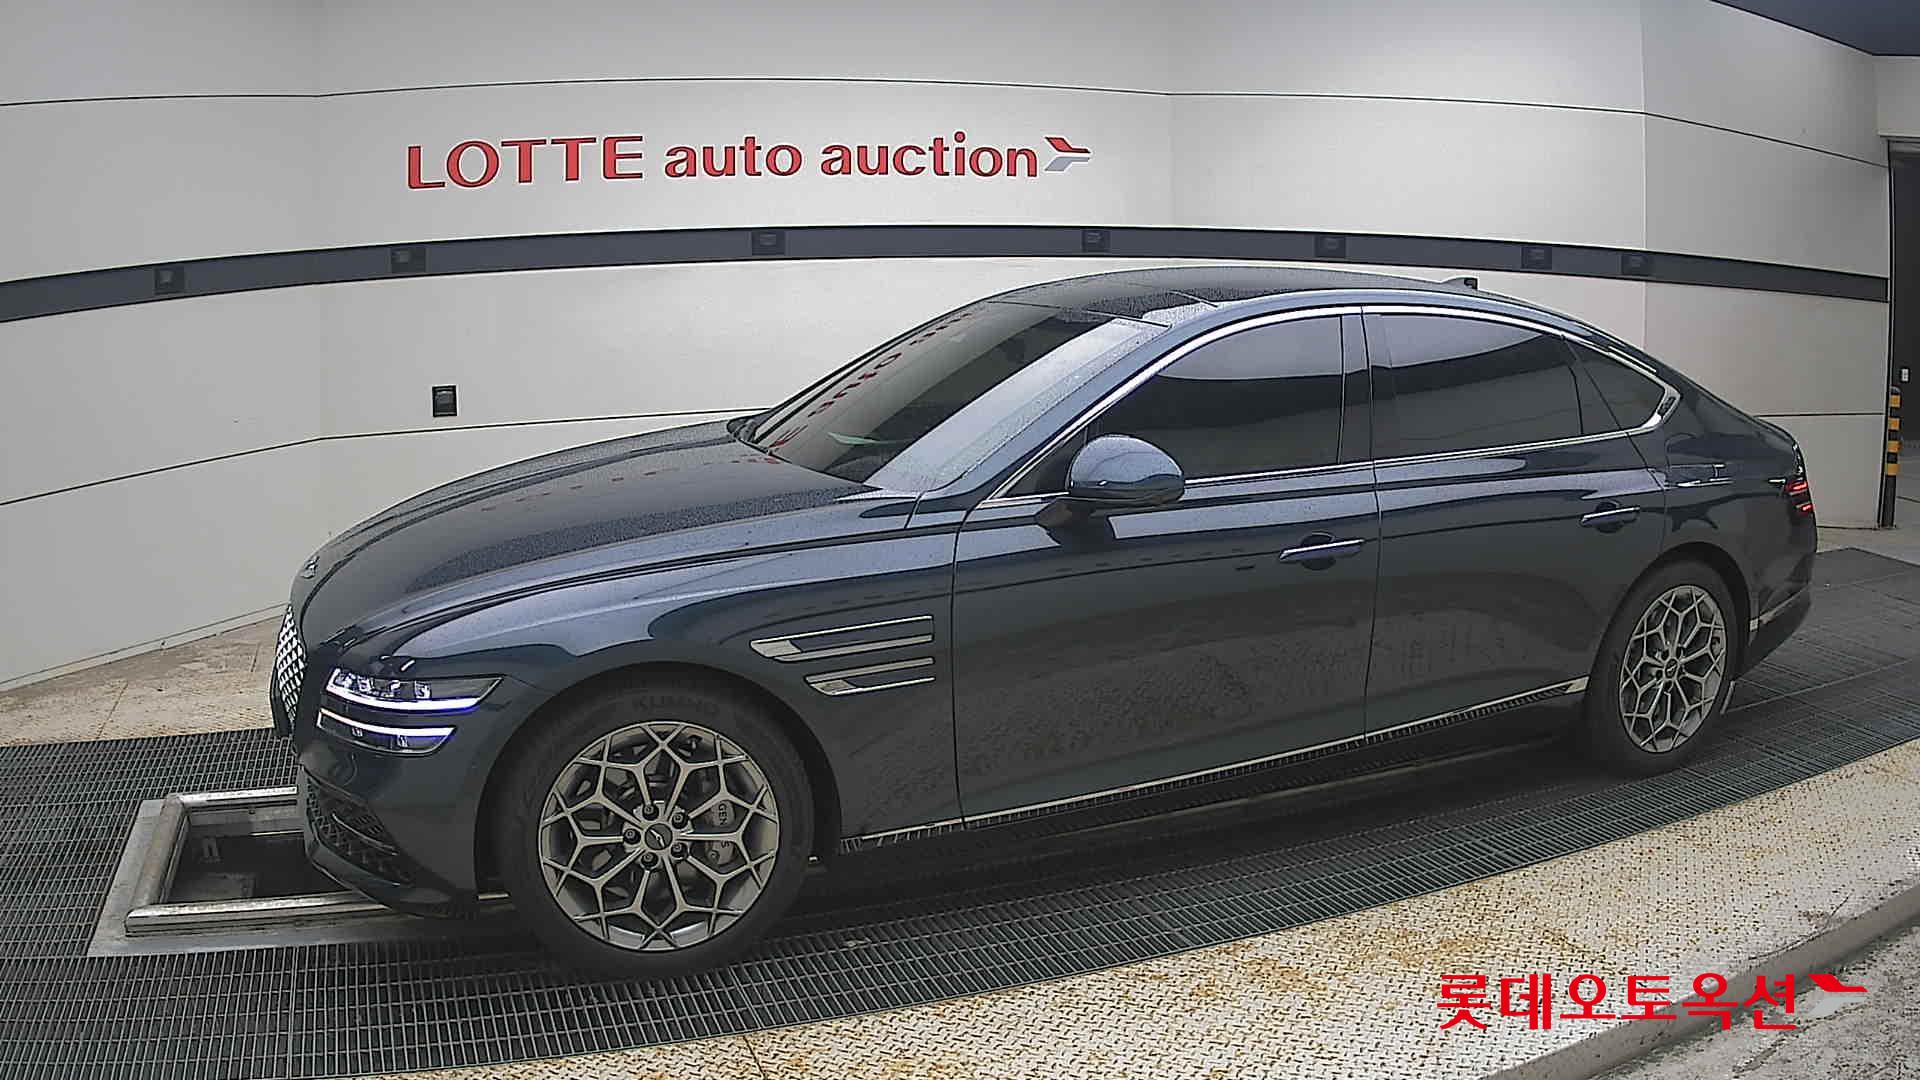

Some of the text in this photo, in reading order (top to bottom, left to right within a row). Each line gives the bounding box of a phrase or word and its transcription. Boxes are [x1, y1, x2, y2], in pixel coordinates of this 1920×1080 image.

[407, 131, 1037, 189] LOTTE auto auction
